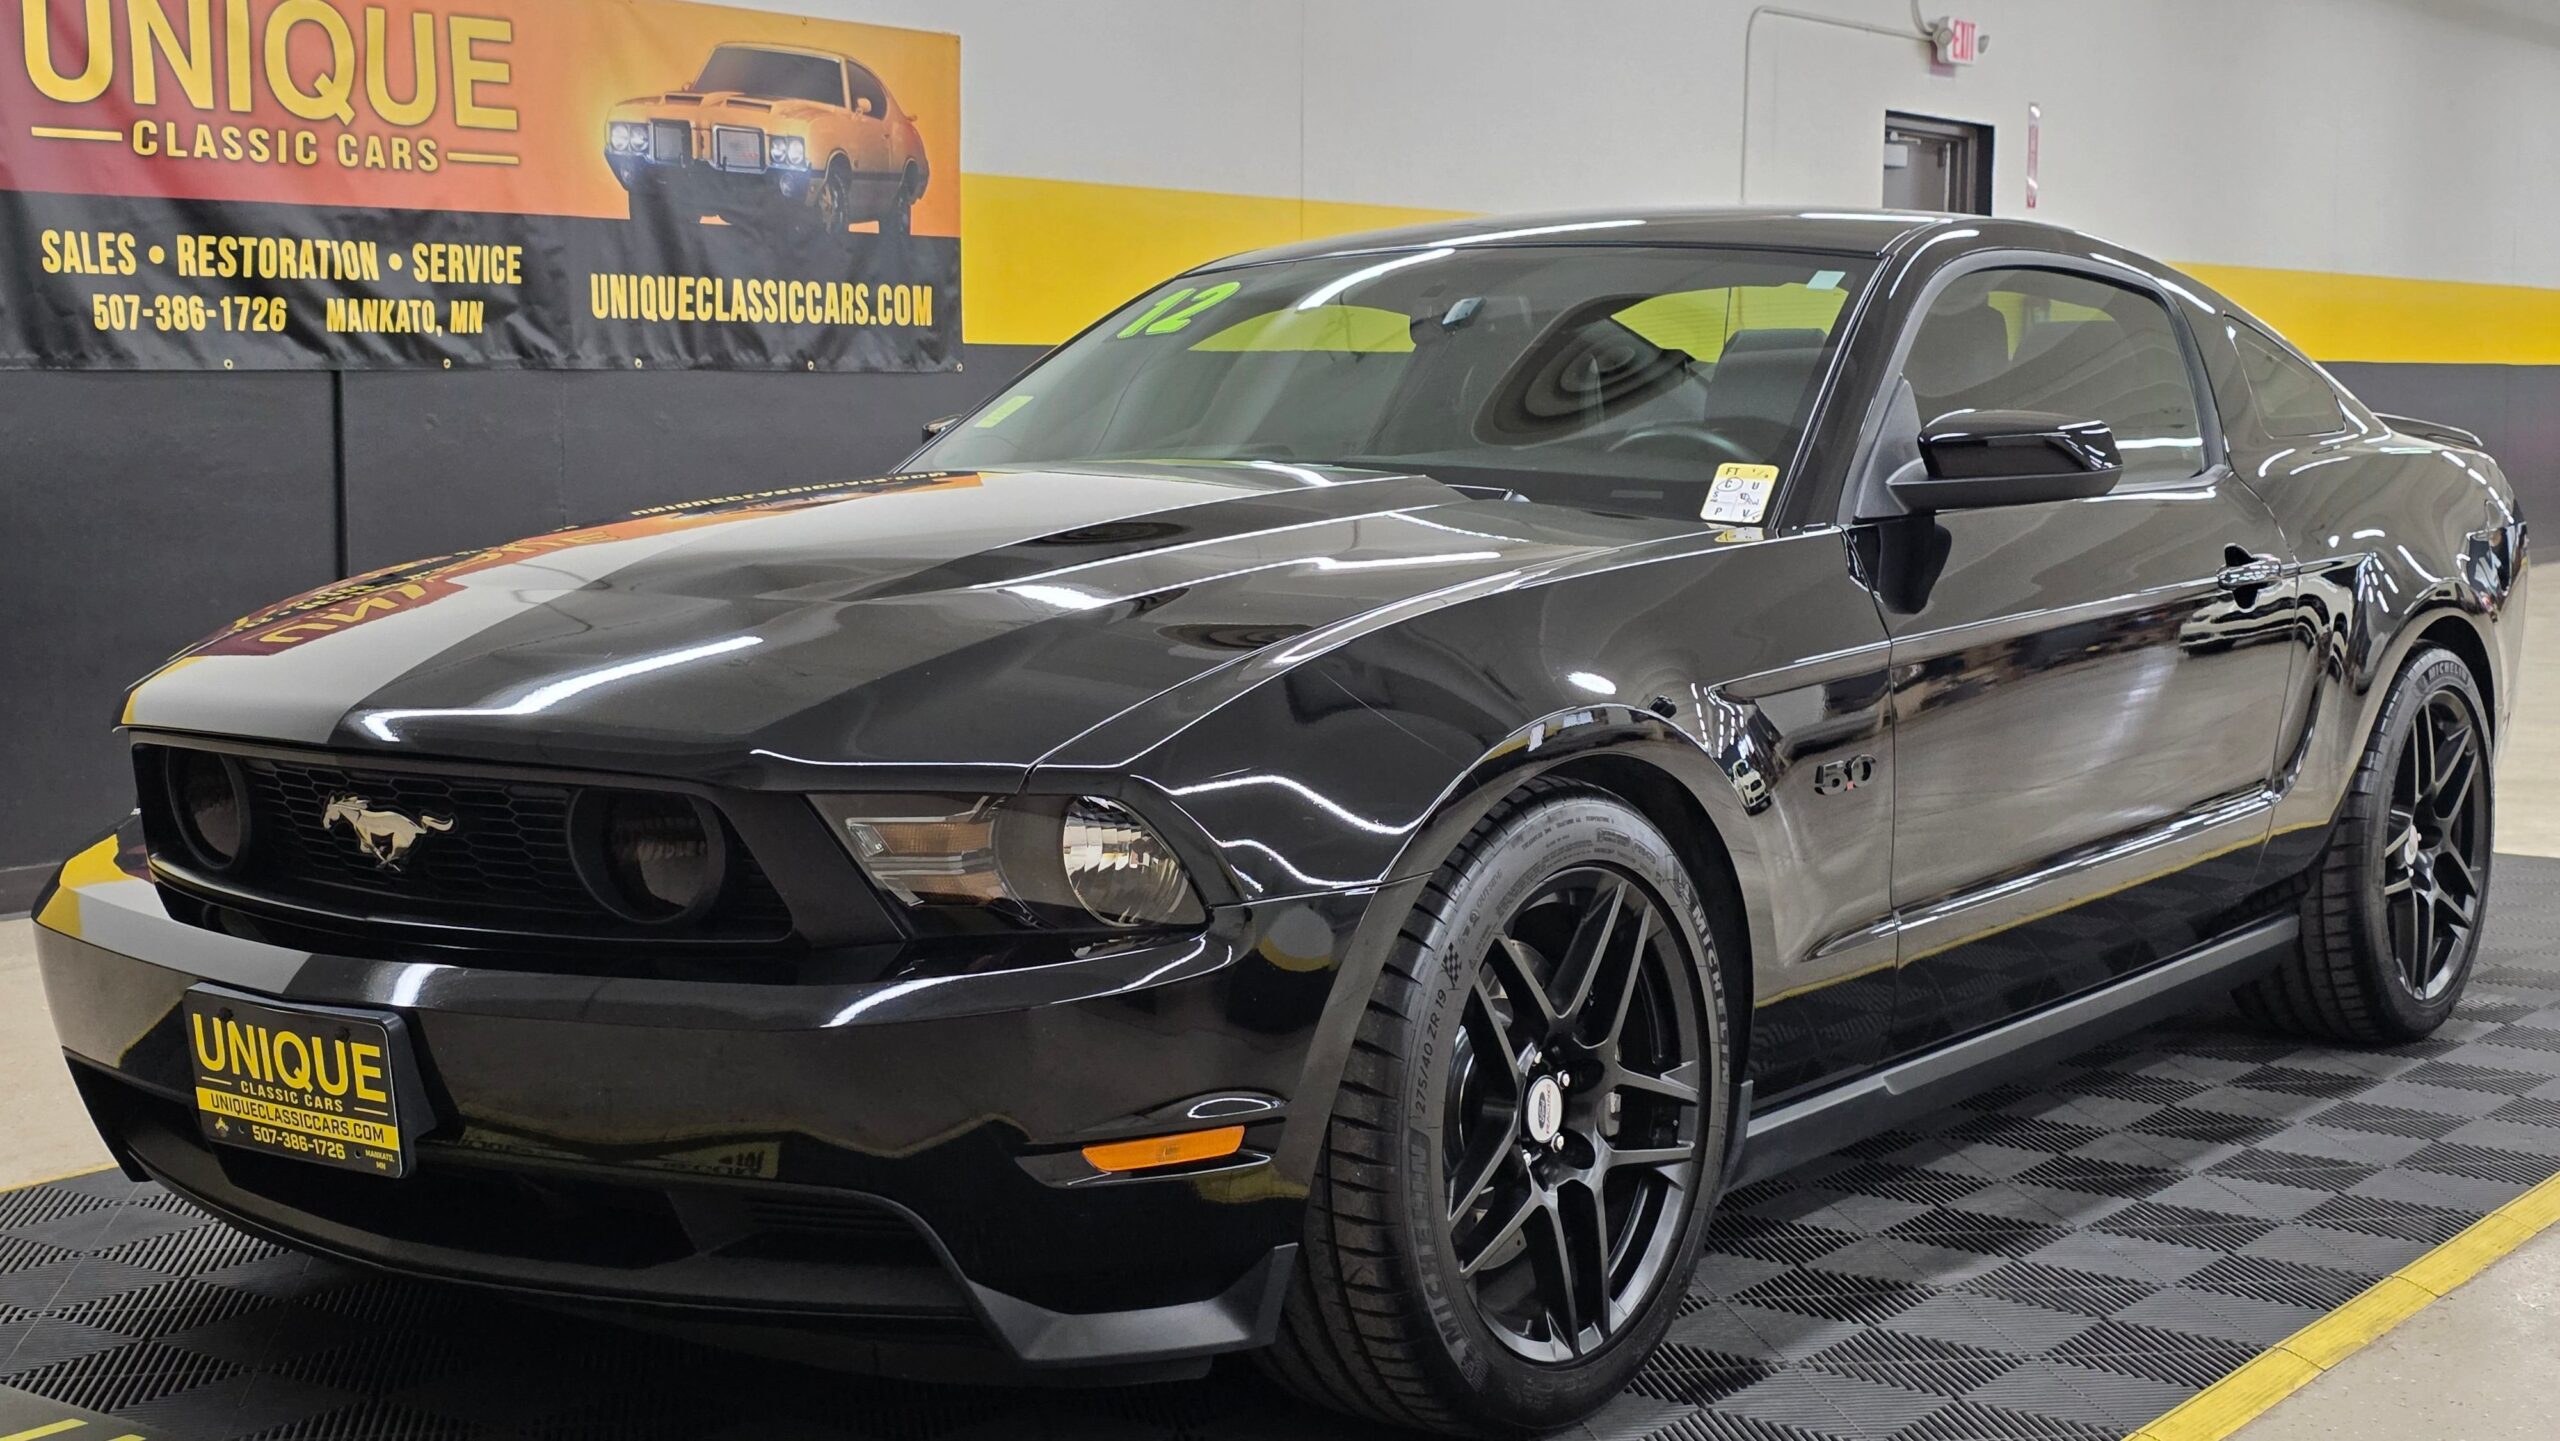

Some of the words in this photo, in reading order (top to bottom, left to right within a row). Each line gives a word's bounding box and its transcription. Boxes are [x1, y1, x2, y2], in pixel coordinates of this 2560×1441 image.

[20, 0, 519, 131] UNIQUE
[1952, 19, 1976, 62] EXIT
[132, 120, 319, 166] CLASSIC
[338, 133, 440, 172] CARS
[40, 228, 138, 276] SALES
[176, 234, 381, 282] RESTORATION
[412, 243, 523, 285] SERVICE
[93, 293, 288, 332] 507-386-1726
[326, 298, 444, 338] MANKATO,
[450, 300, 485, 335] MN
[590, 272, 934, 327] UNIQUECLASSICCARS.COM
[1116, 281, 1242, 340] 12
[1691, 902, 1731, 1084] MICHELIN
[192, 1013, 387, 1103] UNIQUE
[1415, 1044, 1434, 1114] 275/40
[1427, 1014, 1441, 1041] ZR
[1437, 988, 1448, 1010] 19
[210, 1092, 386, 1143] UNIQUECLASSICCARS.COM
[240, 1079, 299, 1105] CLASSIC
[304, 1094, 345, 1113] CARS
[251, 1124, 347, 1160] 507-386-1726
